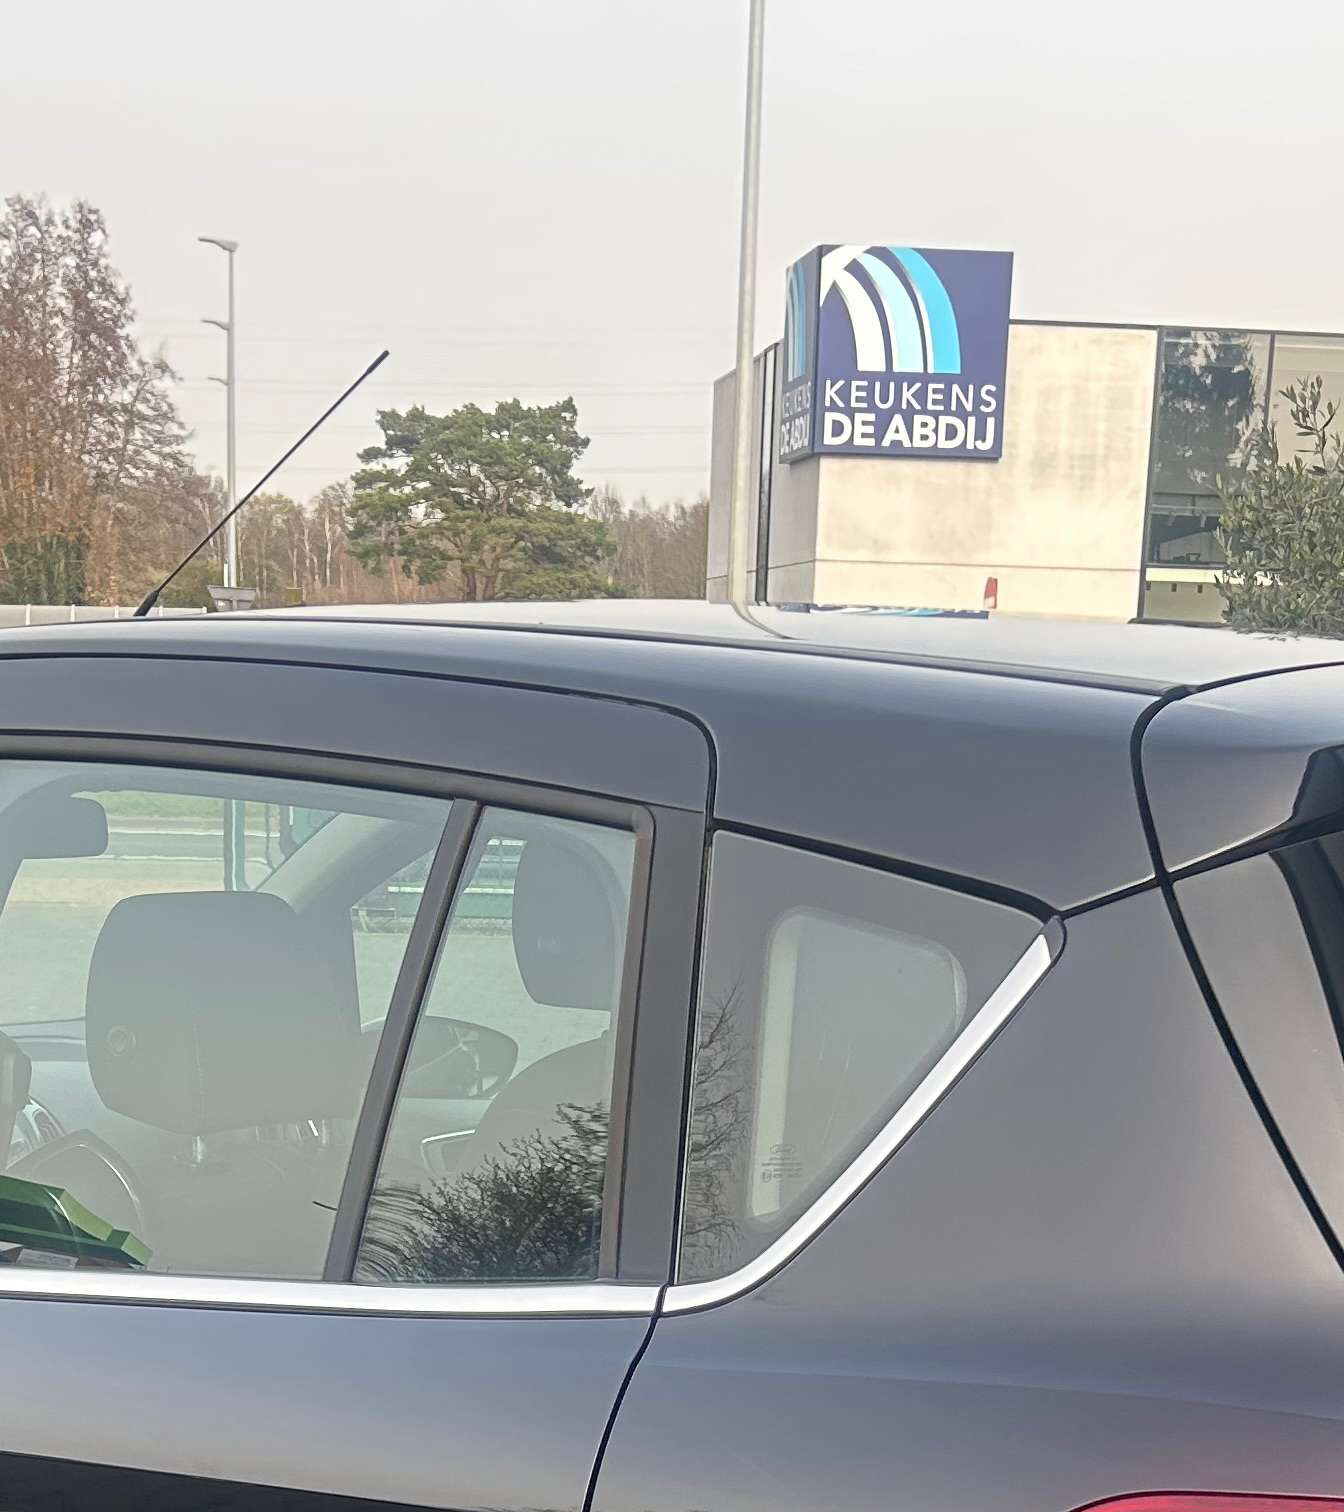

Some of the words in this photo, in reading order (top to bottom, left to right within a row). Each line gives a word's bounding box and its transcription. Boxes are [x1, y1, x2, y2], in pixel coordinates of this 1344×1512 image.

[824, 379, 997, 413] KEUKENS
[823, 412, 876, 446] DE
[881, 414, 995, 450] ABDIJ
